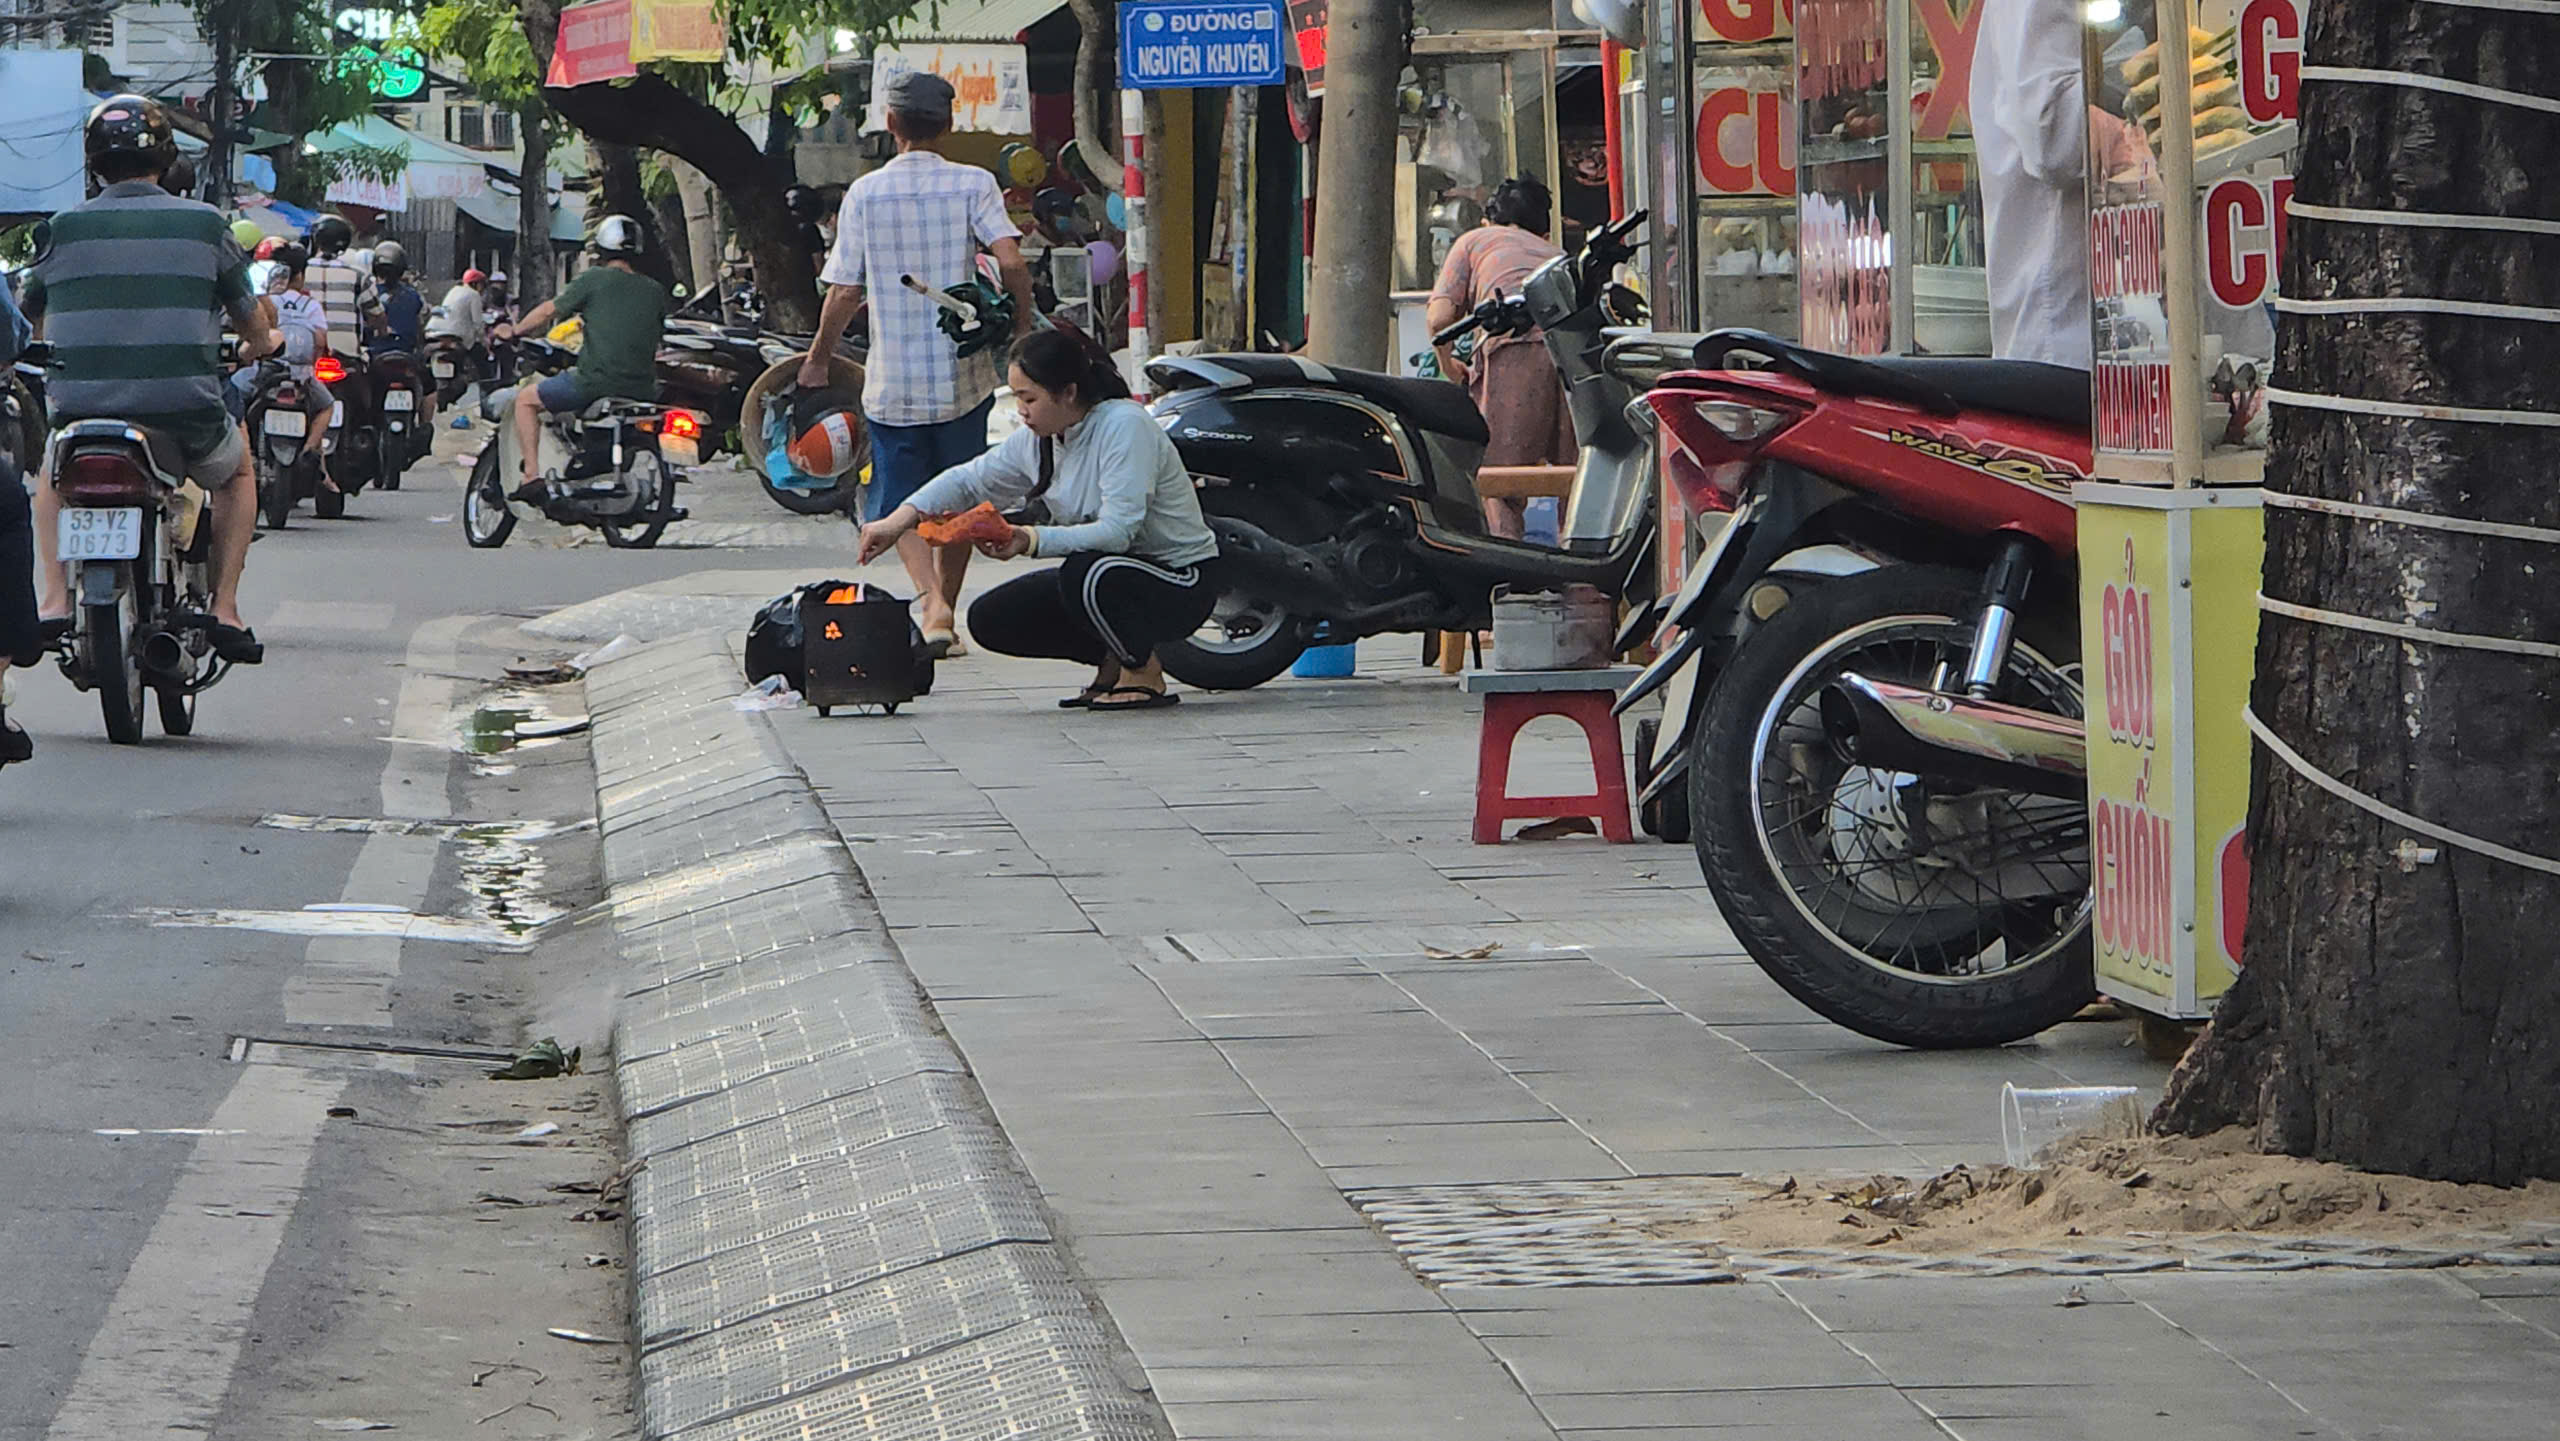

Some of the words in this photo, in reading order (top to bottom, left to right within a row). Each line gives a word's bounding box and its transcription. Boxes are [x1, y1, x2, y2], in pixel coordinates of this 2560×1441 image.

[1170, 9, 1253, 32] ĐƯỜNG
[1138, 36, 1201, 76] NGUYỄN
[1207, 34, 1270, 74] KHUYẾN
[1890, 429, 1987, 465] WAVE
[70, 510, 128, 531] 53-V2
[70, 533, 128, 555] 0673
[2103, 536, 2155, 748] GỎI
[2096, 753, 2172, 976] CUỐN
